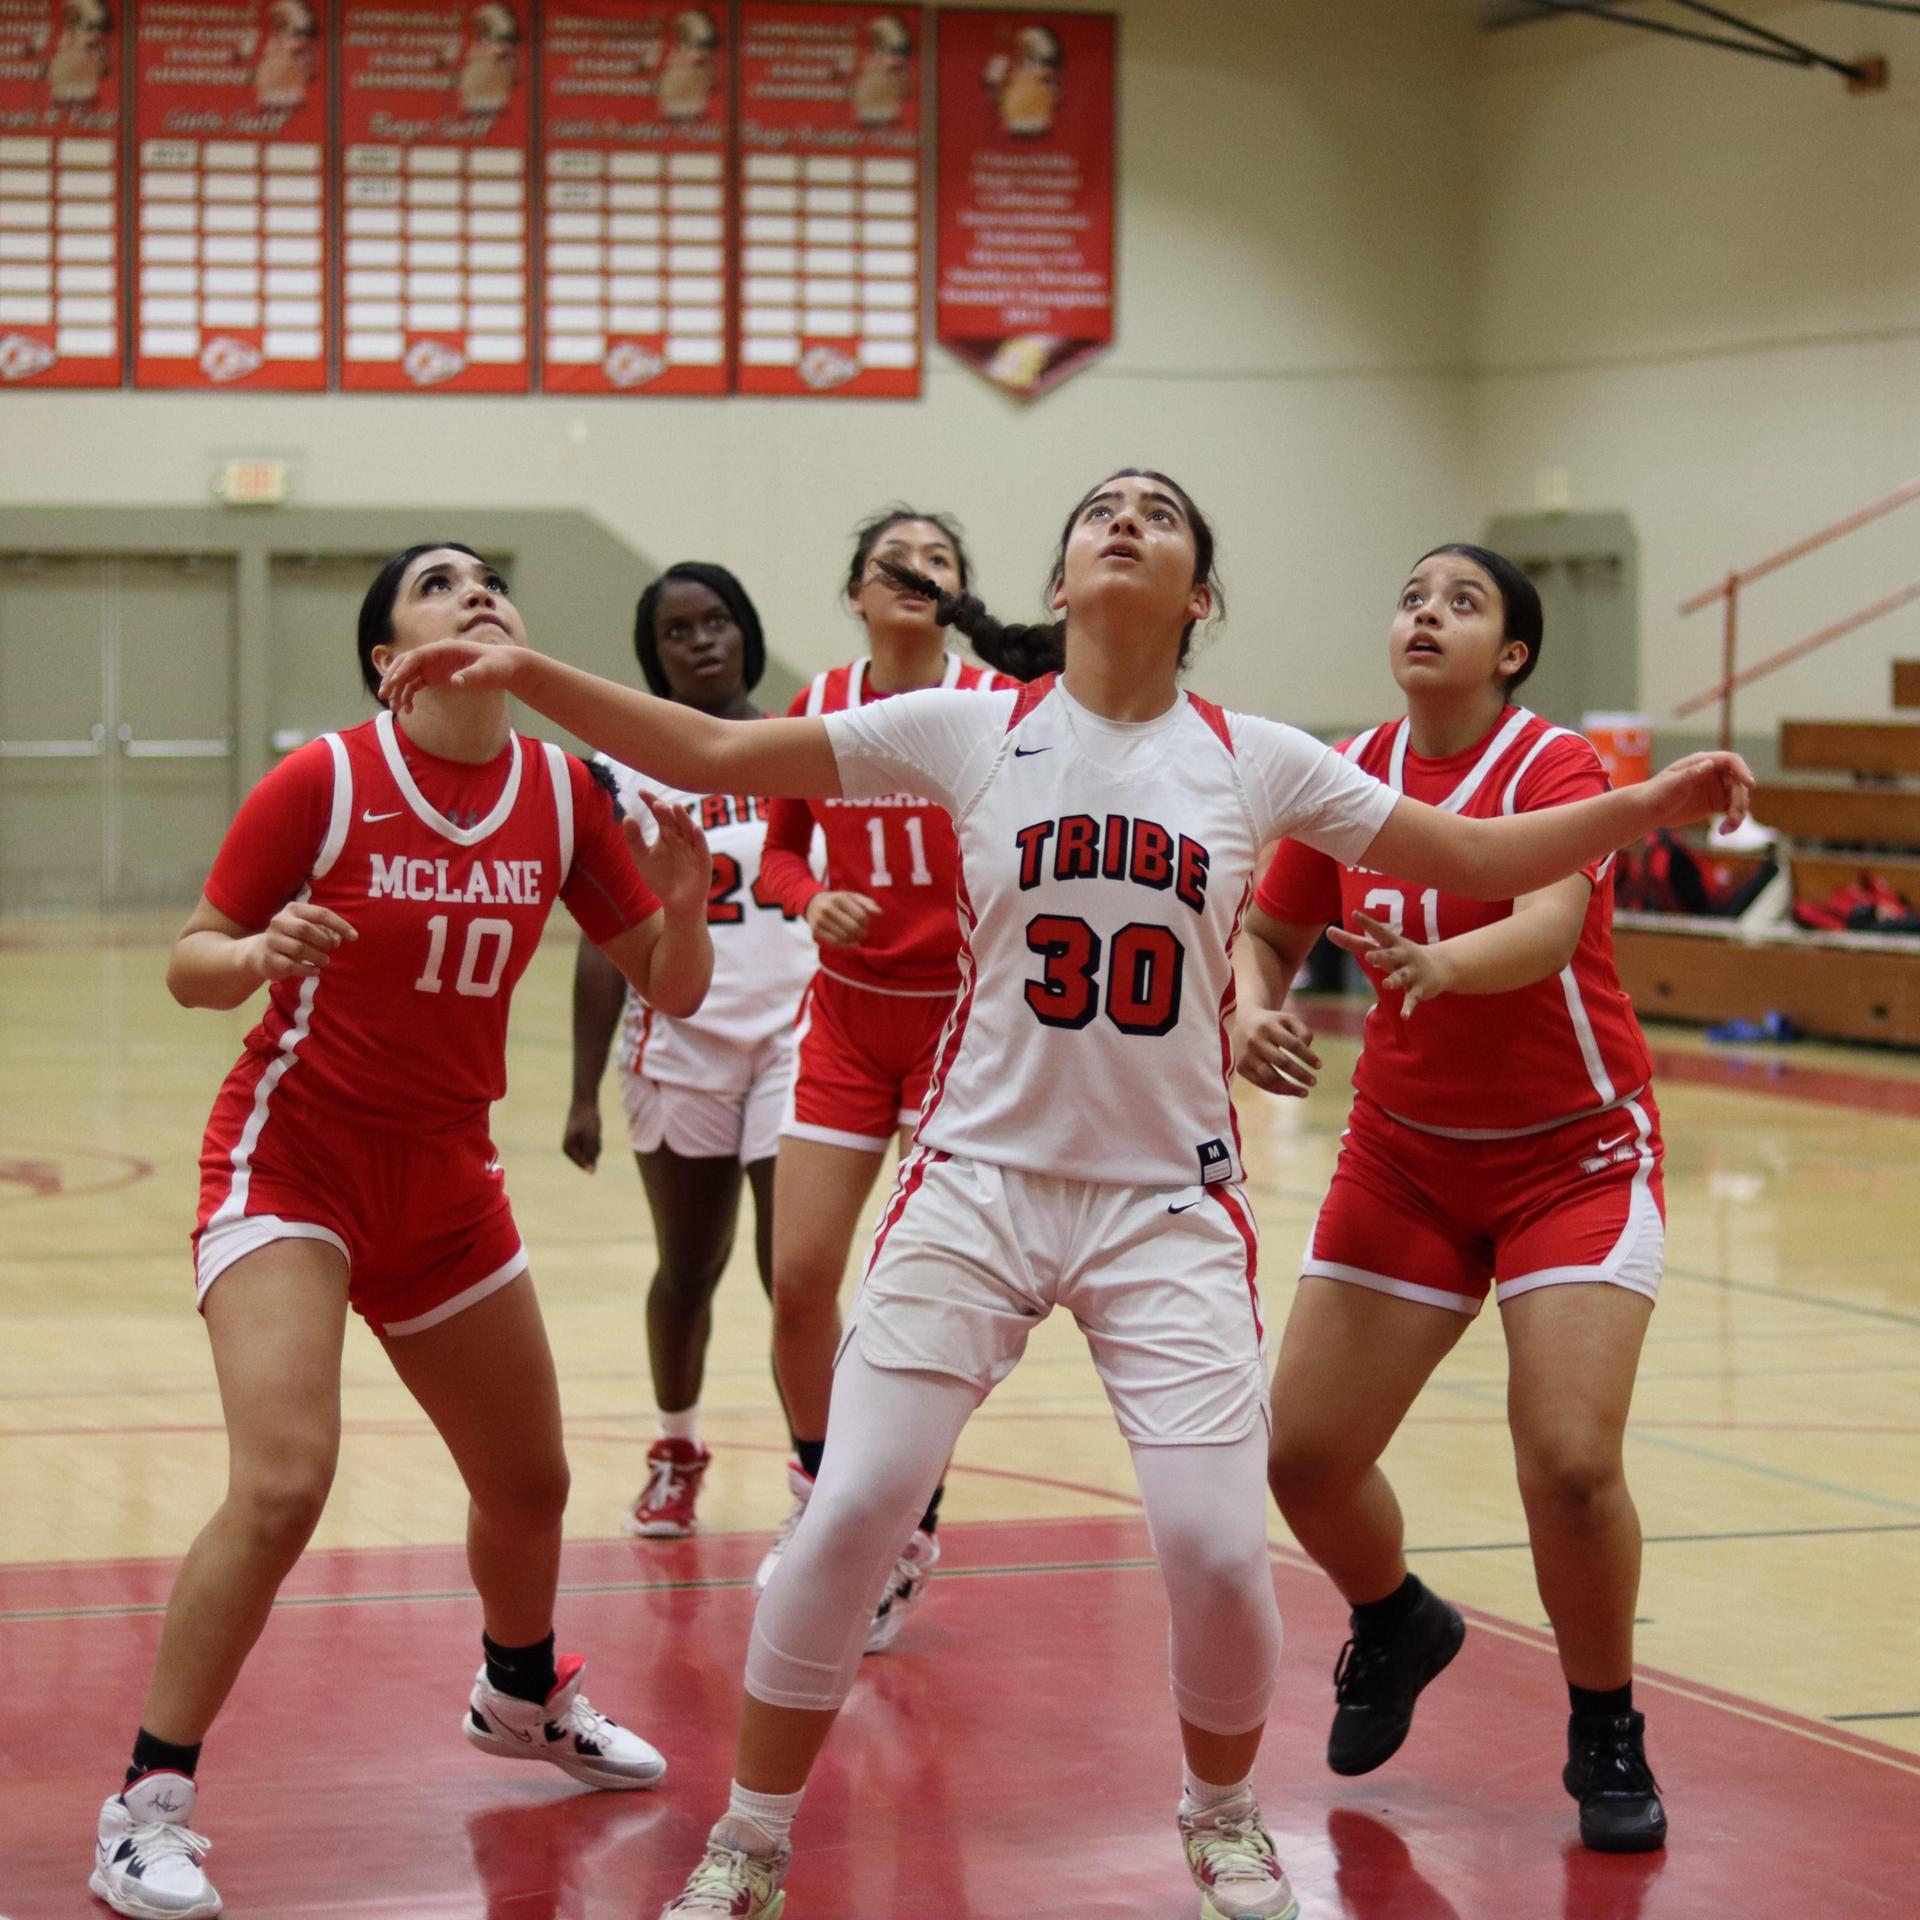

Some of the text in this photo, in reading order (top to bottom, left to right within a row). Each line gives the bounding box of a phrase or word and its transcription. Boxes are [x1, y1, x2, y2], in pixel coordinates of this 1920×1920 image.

[367, 853, 542, 905] MCLANE
[865, 816, 934, 888] 11
[1015, 813, 1211, 915] TRIBE
[414, 914, 514, 998] 10
[1023, 913, 1186, 1037] 30
[1207, 1144, 1221, 1160] M
